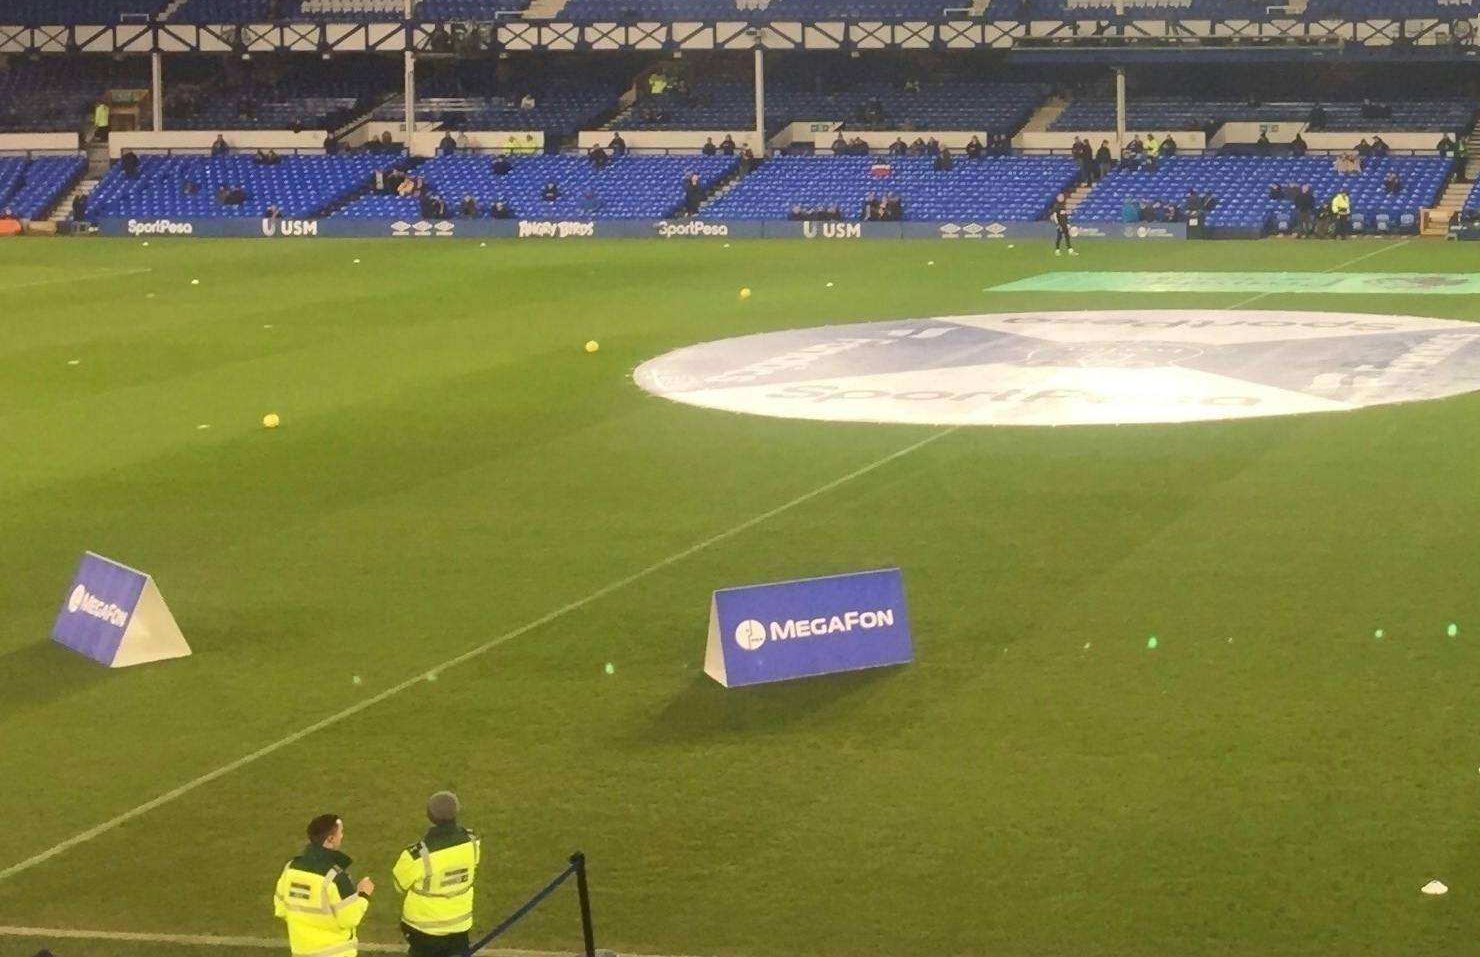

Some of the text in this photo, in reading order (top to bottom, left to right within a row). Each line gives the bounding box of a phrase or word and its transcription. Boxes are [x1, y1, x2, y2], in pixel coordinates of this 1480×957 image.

[127, 218, 193, 236] SportPesa
[280, 220, 318, 236] USM
[658, 221, 728, 238] SportPesa
[822, 222, 862, 238] USM
[765, 384, 1262, 407] SportPa
[769, 608, 895, 642] MEGAFON
